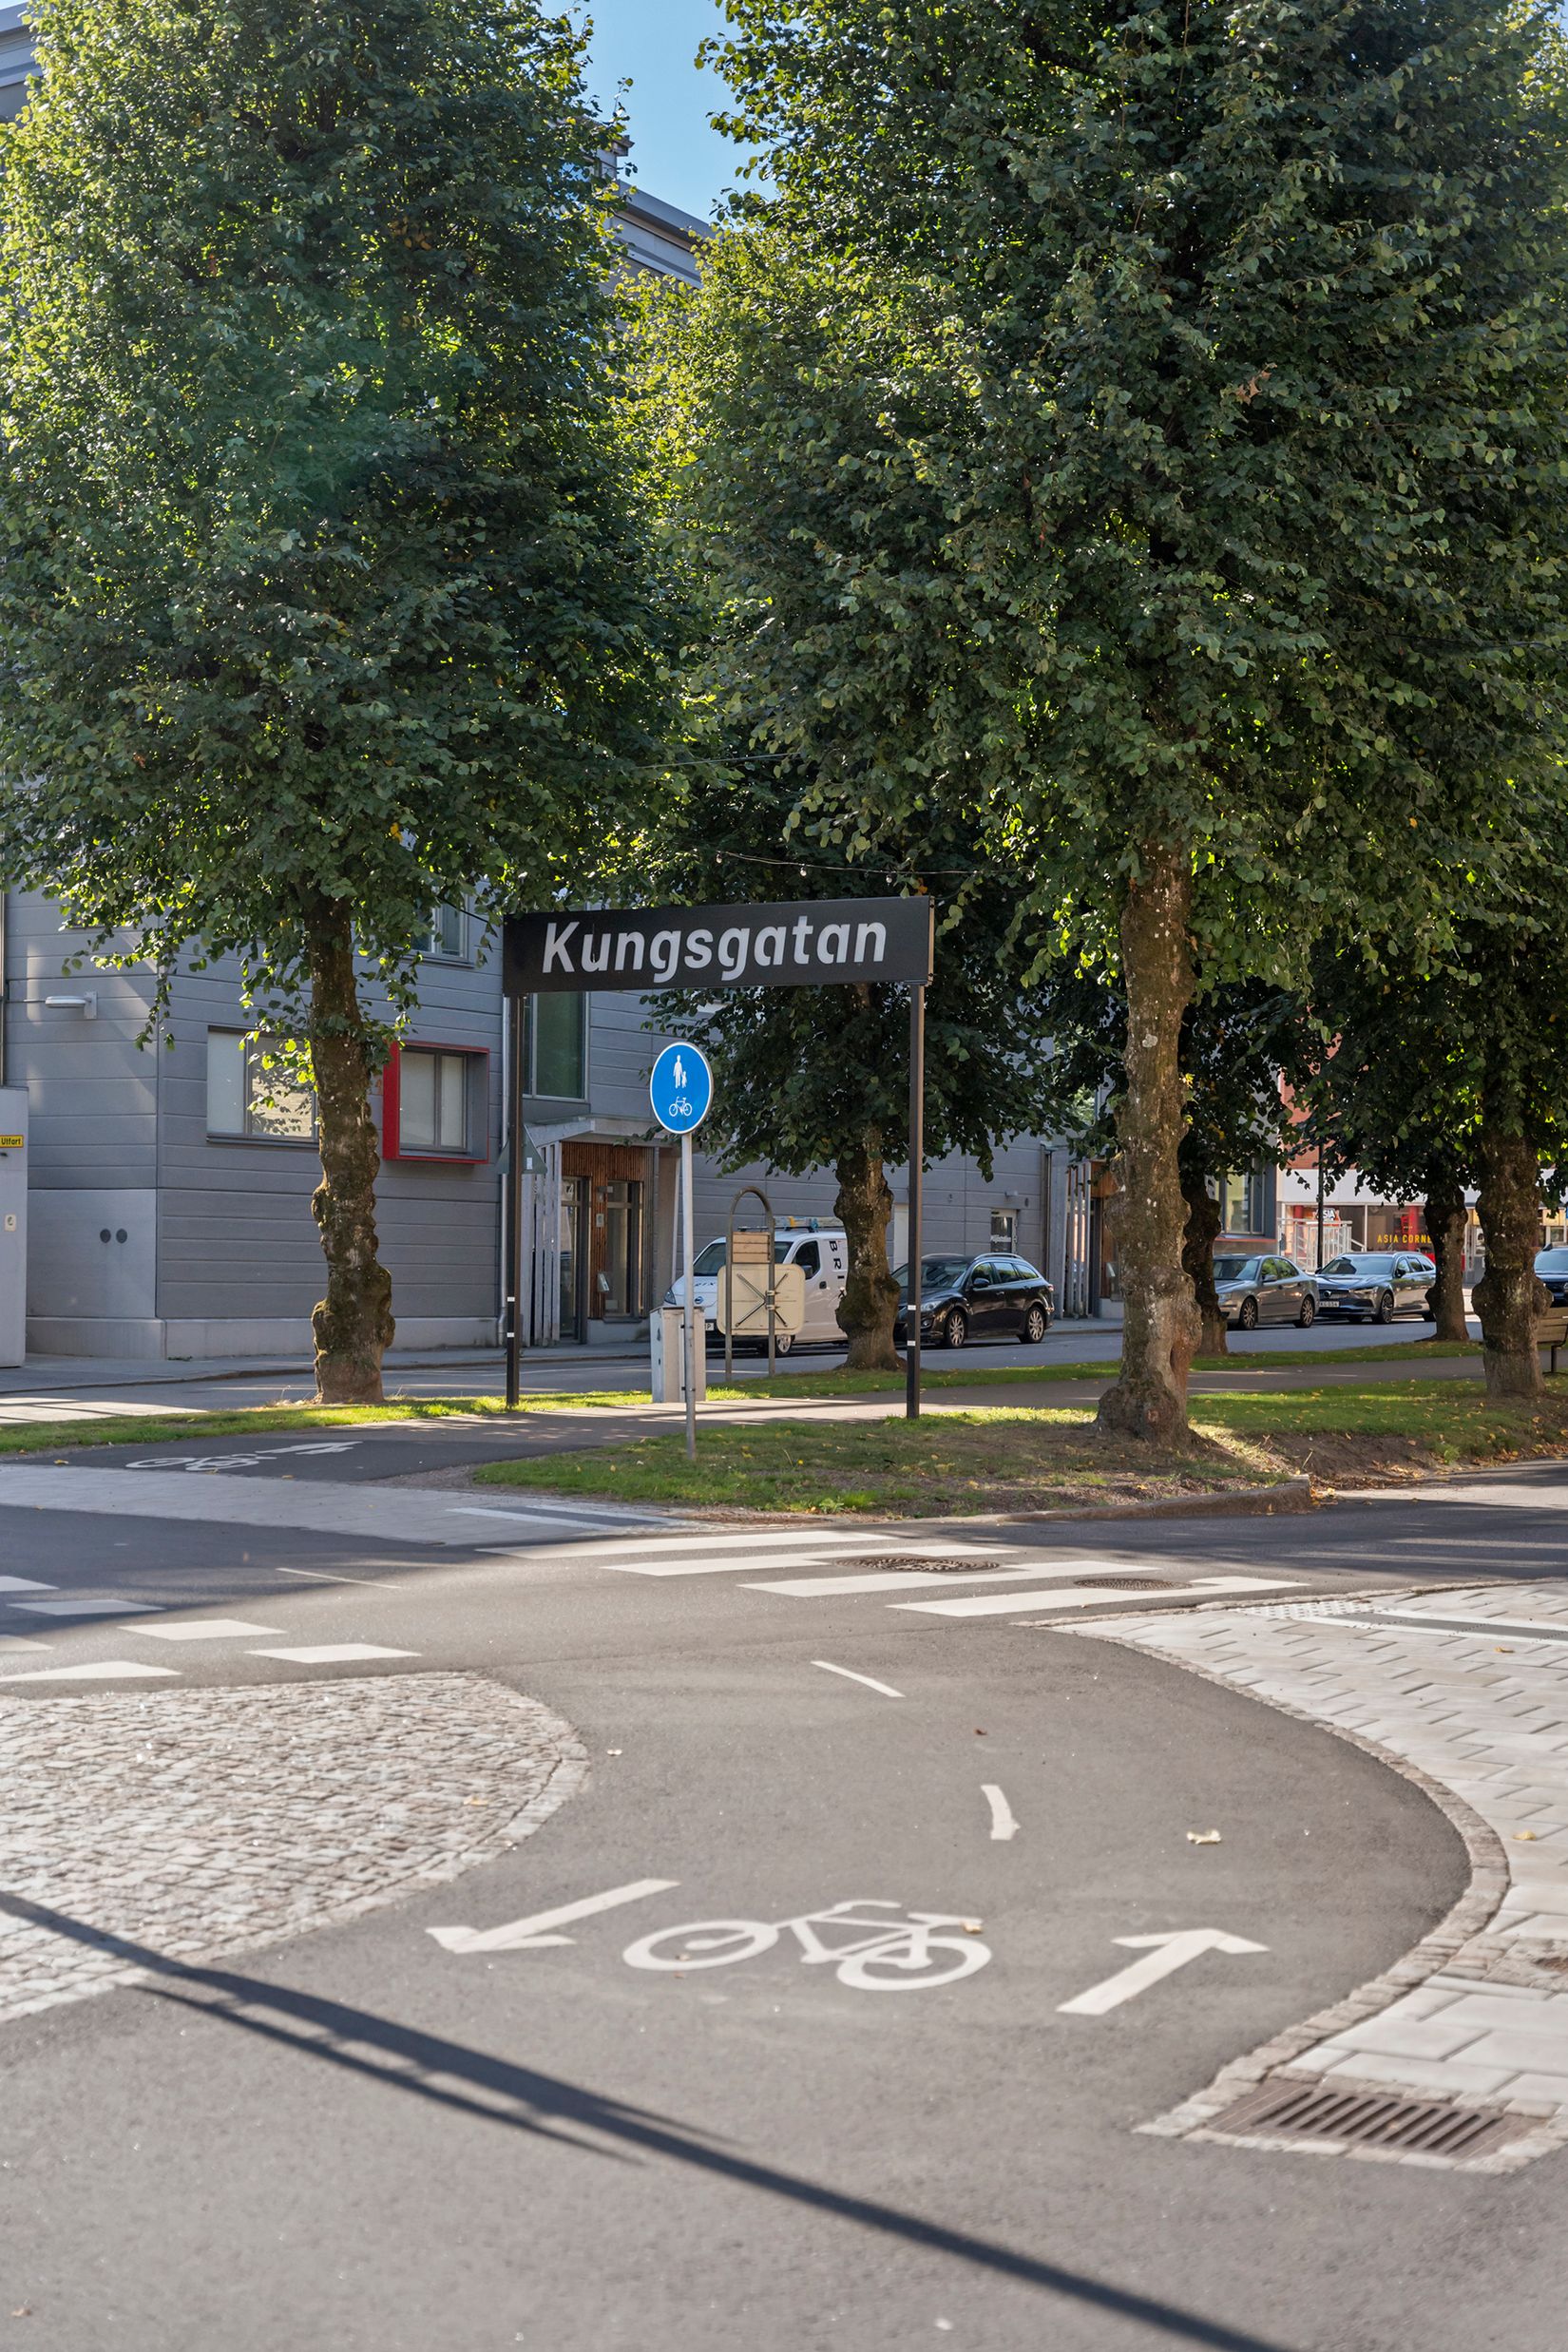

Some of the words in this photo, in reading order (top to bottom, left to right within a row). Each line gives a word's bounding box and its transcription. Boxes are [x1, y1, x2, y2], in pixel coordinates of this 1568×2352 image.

[541, 915, 888, 984] Kungsgatan
[1, 1137, 21, 1145] Utfart
[1377, 1234, 1398, 1243] ASIA
